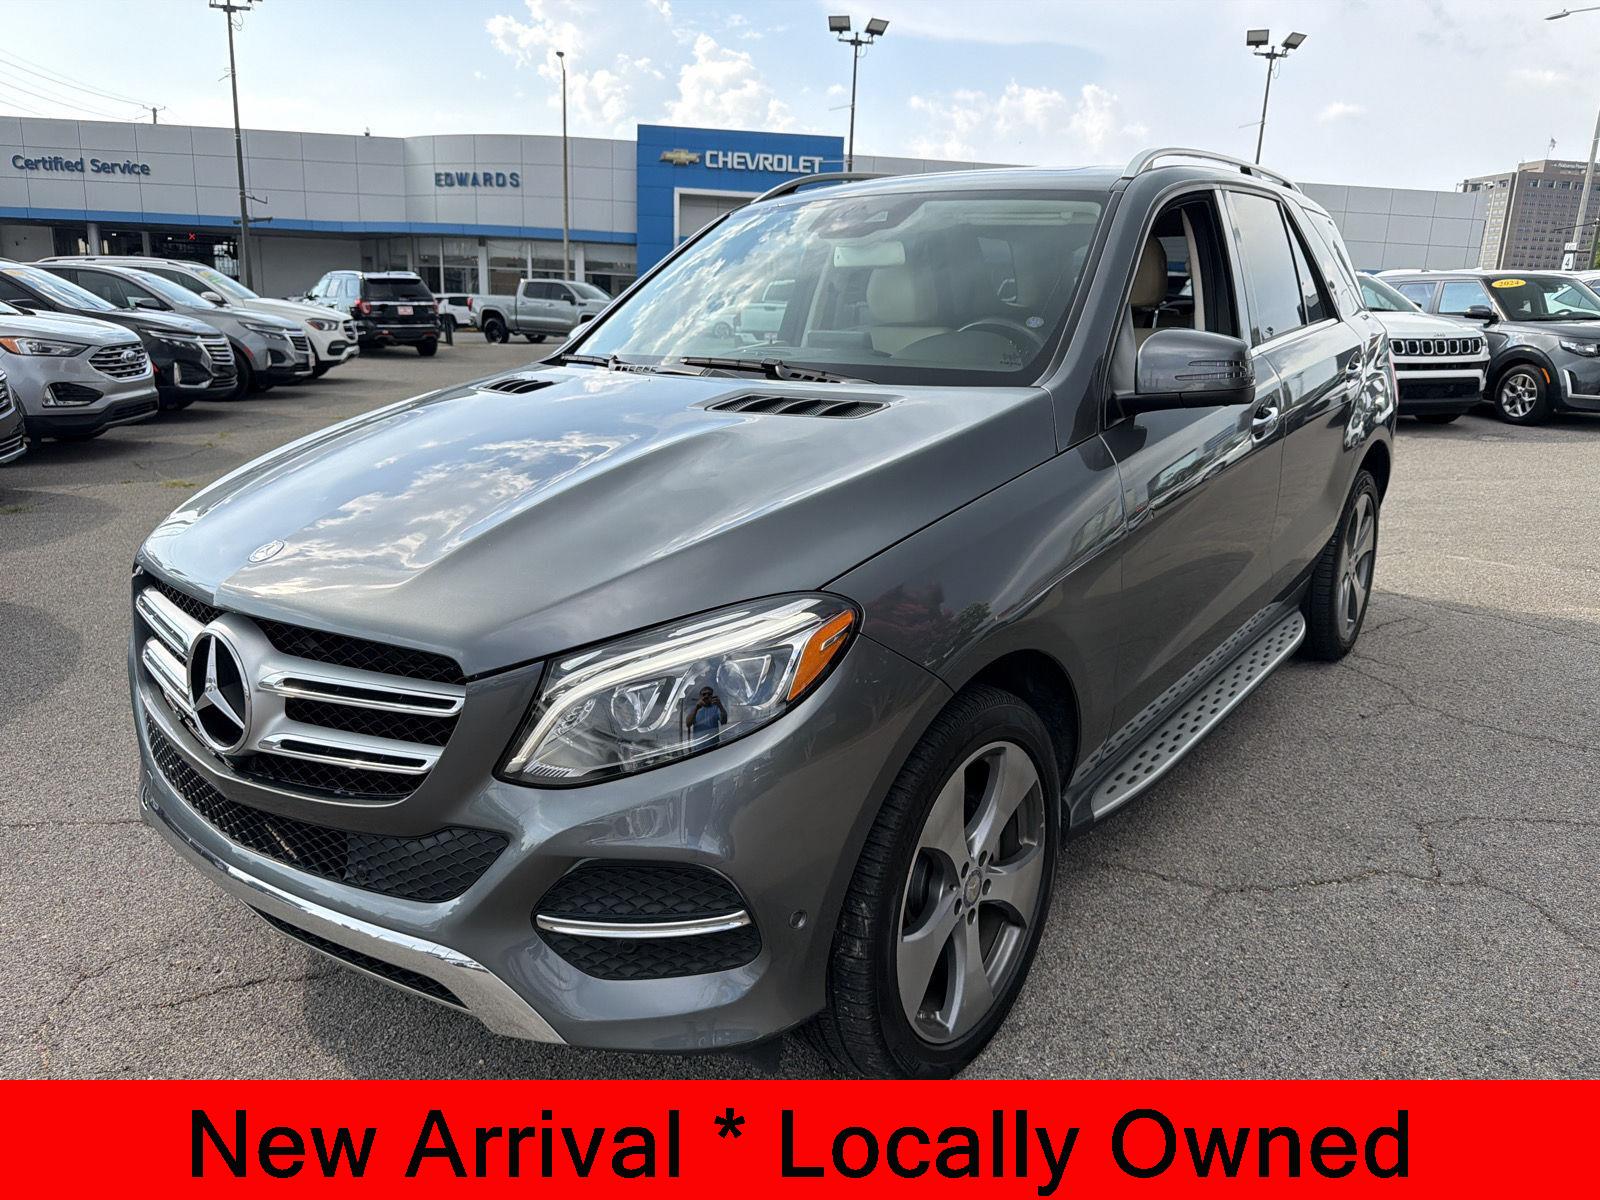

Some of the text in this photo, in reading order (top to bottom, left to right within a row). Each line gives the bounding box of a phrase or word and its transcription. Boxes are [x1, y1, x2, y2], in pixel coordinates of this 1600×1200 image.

[11, 154, 151, 176] Certified Service
[705, 150, 824, 174] CHEVROLET
[434, 171, 521, 188] EDWARDS
